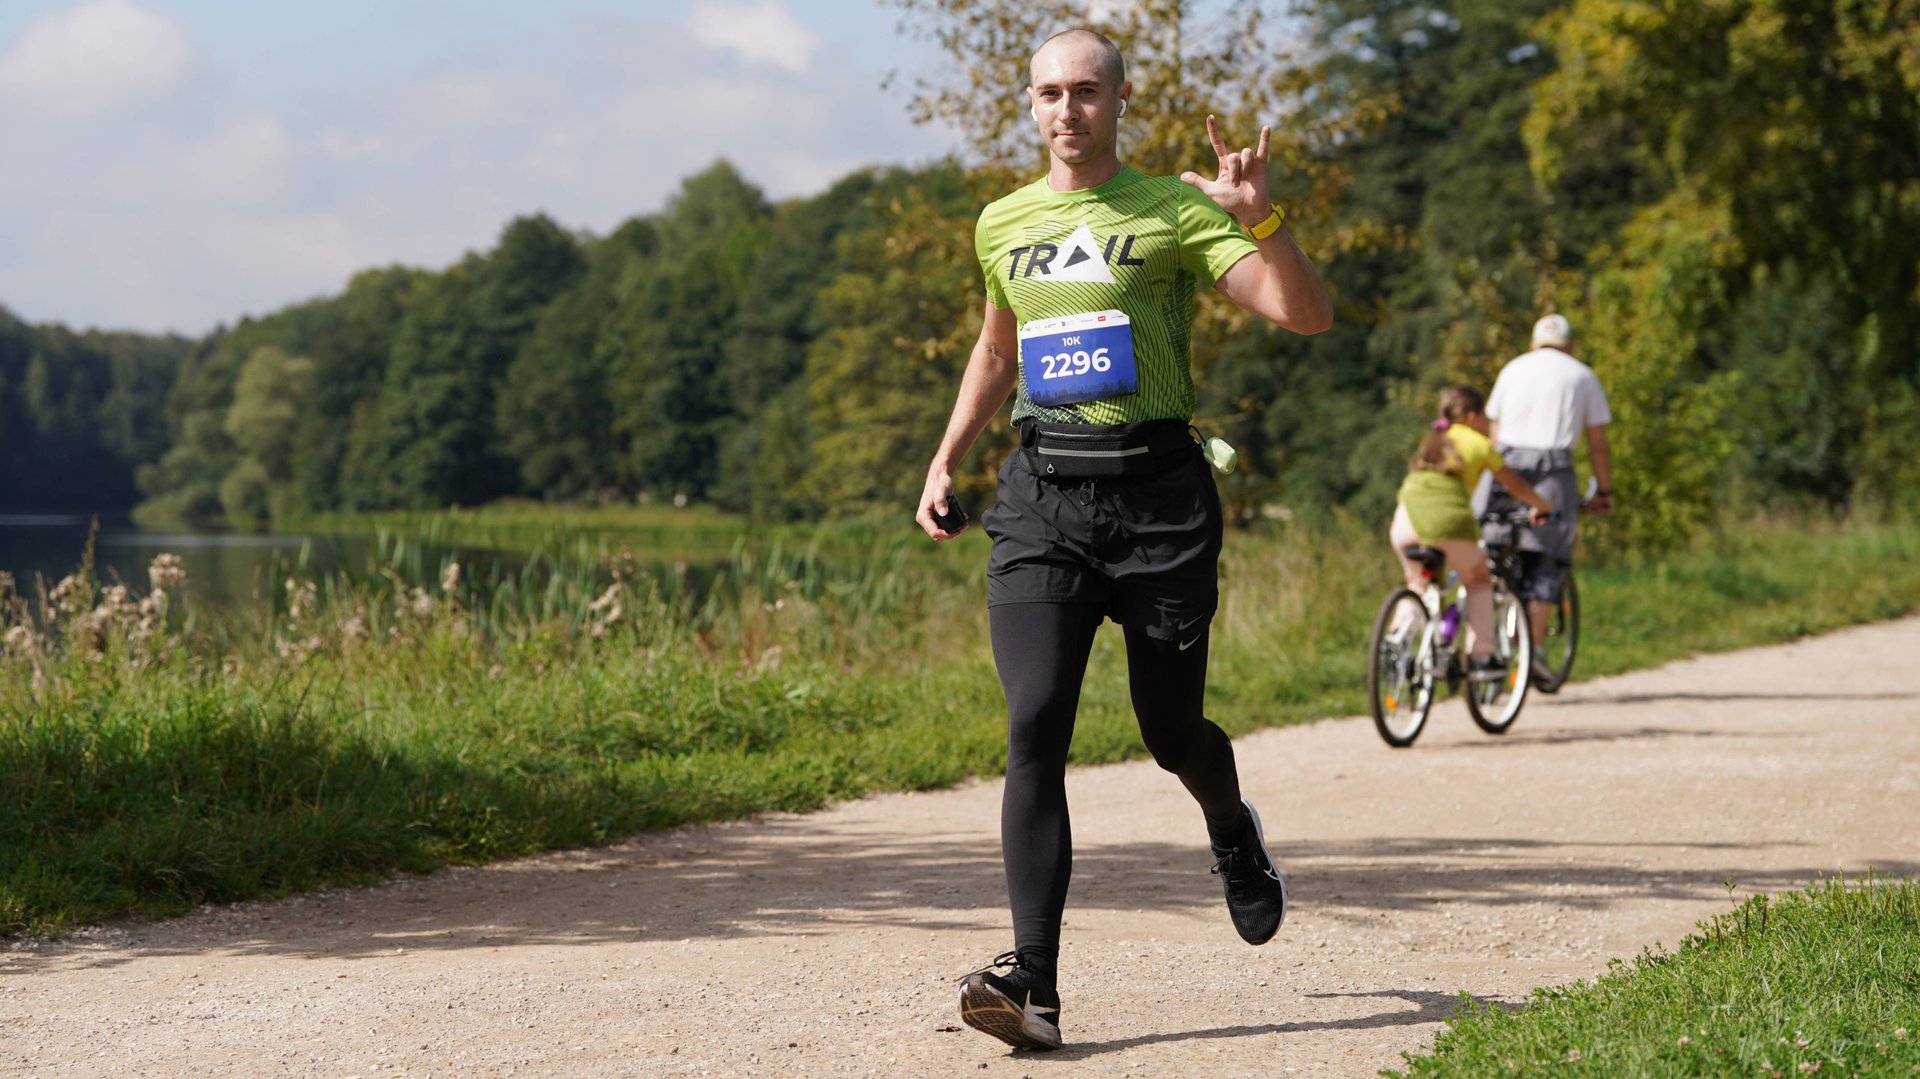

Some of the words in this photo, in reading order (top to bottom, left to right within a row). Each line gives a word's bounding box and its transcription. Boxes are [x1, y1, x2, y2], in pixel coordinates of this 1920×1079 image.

[1008, 221, 1145, 283] TRAIL
[1062, 335, 1081, 347] 10K
[1040, 347, 1112, 380] 2296
